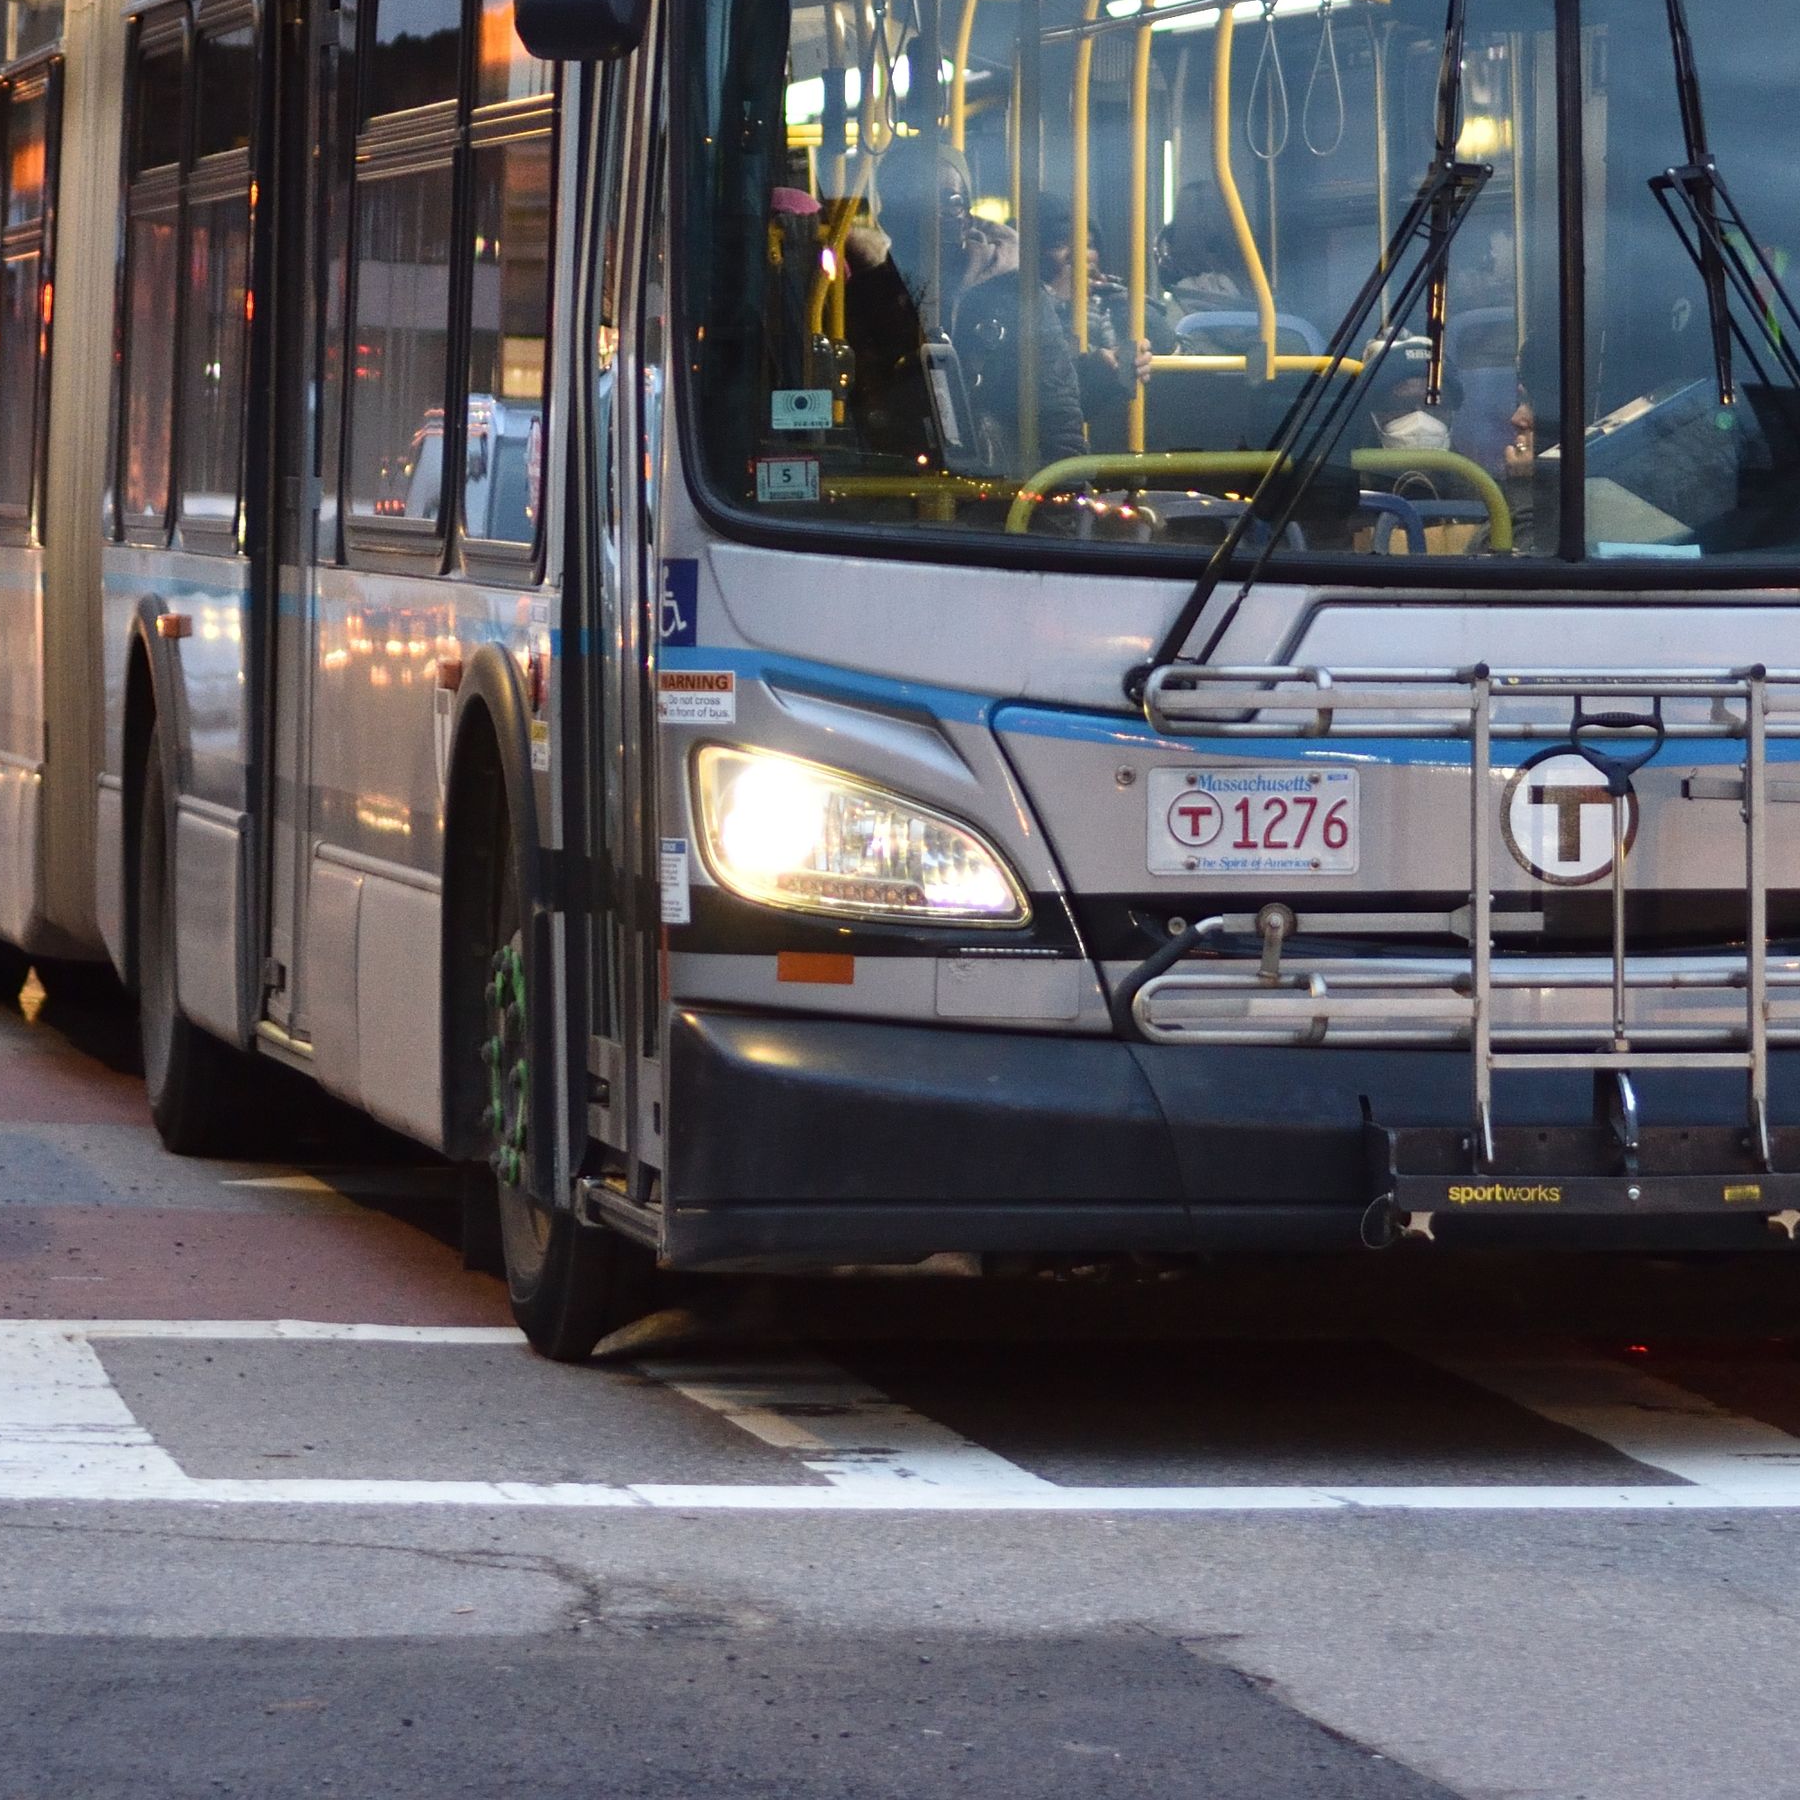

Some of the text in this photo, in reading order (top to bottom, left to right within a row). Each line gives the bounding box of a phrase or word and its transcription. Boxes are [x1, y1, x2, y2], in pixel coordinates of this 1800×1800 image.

[782, 468, 792, 483] 5
[695, 696, 720, 705] cross
[1198, 774, 1312, 793] Massachusetts
[1233, 797, 1348, 849] 1276
[1448, 1183, 1561, 1204] sportworks
